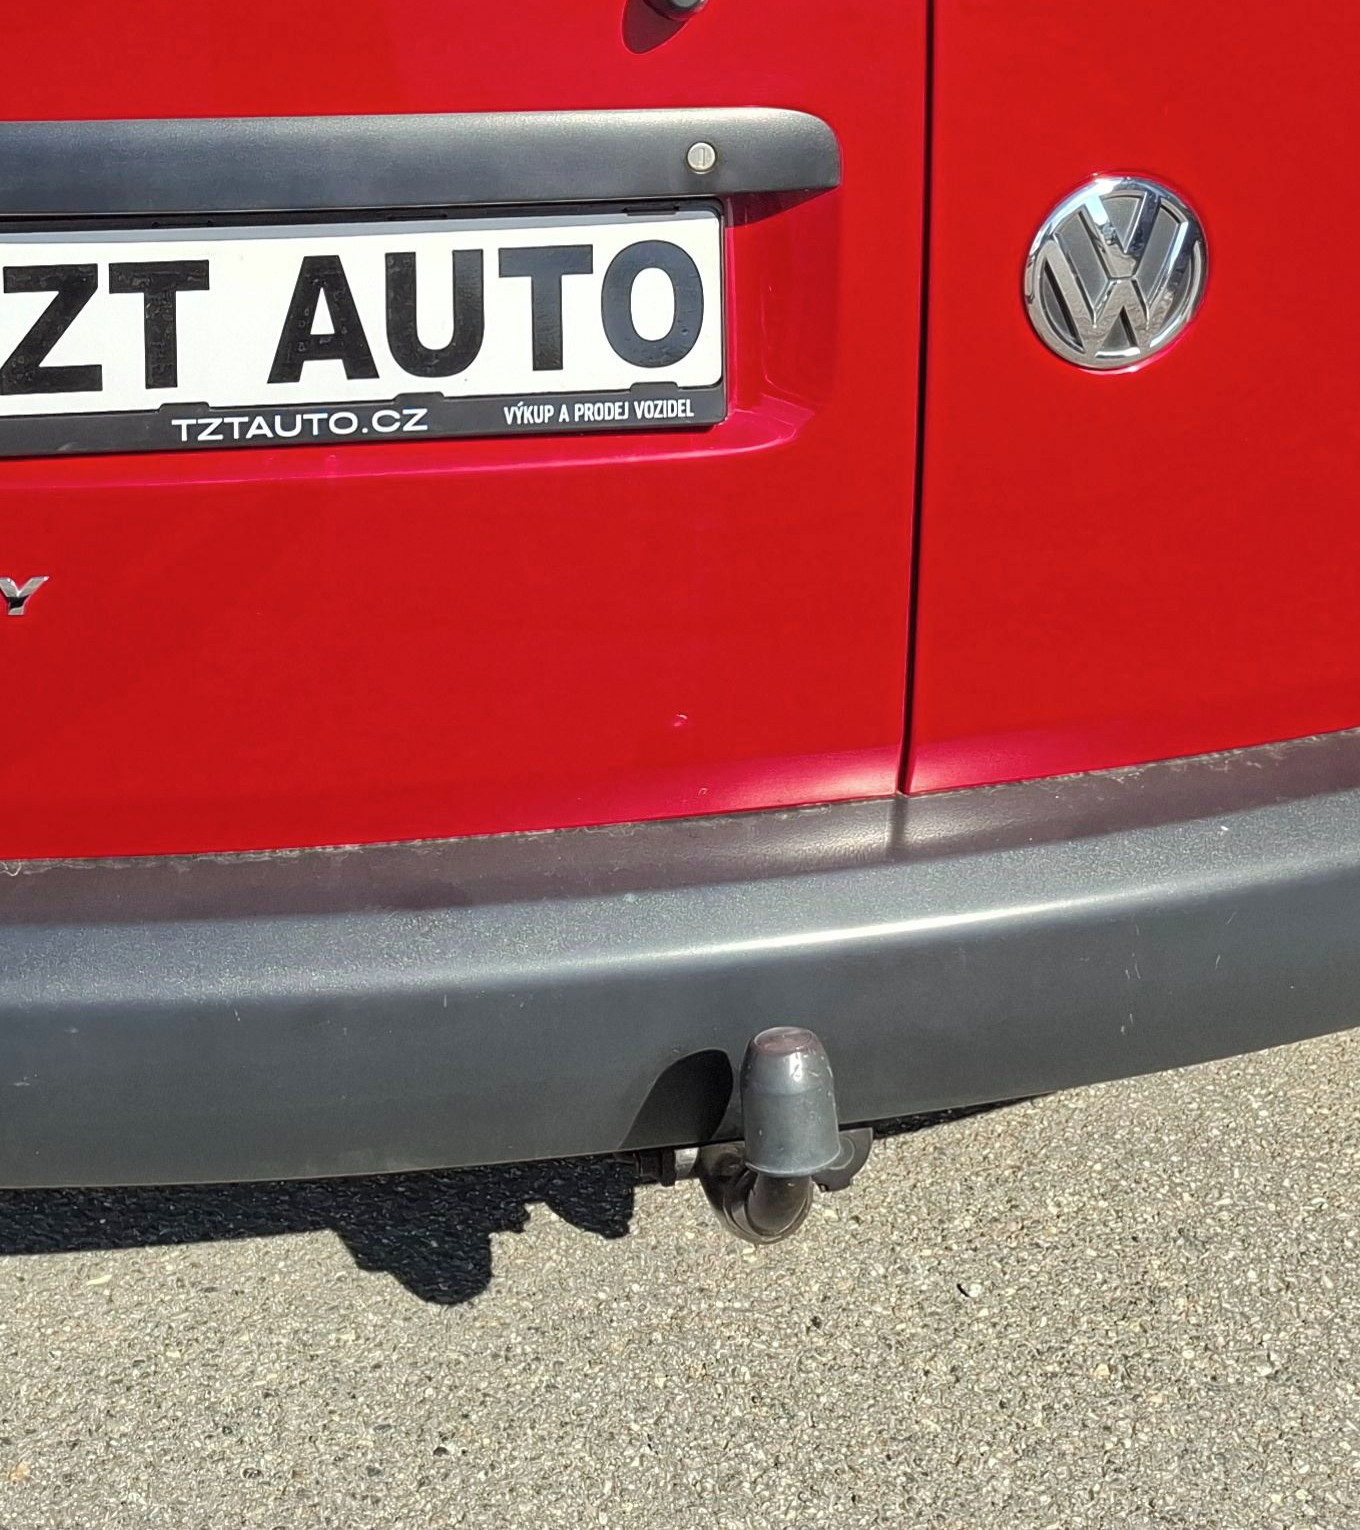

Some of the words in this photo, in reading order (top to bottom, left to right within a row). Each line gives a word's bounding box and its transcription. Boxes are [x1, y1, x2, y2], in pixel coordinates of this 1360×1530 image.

[266, 239, 704, 385] AUTO
[171, 408, 428, 442] TZTAUTO.CZ
[503, 401, 555, 425] VÝKUP
[558, 405, 570, 423] A
[574, 401, 629, 422] PRODEJ
[633, 399, 695, 420] VOZIDEL
